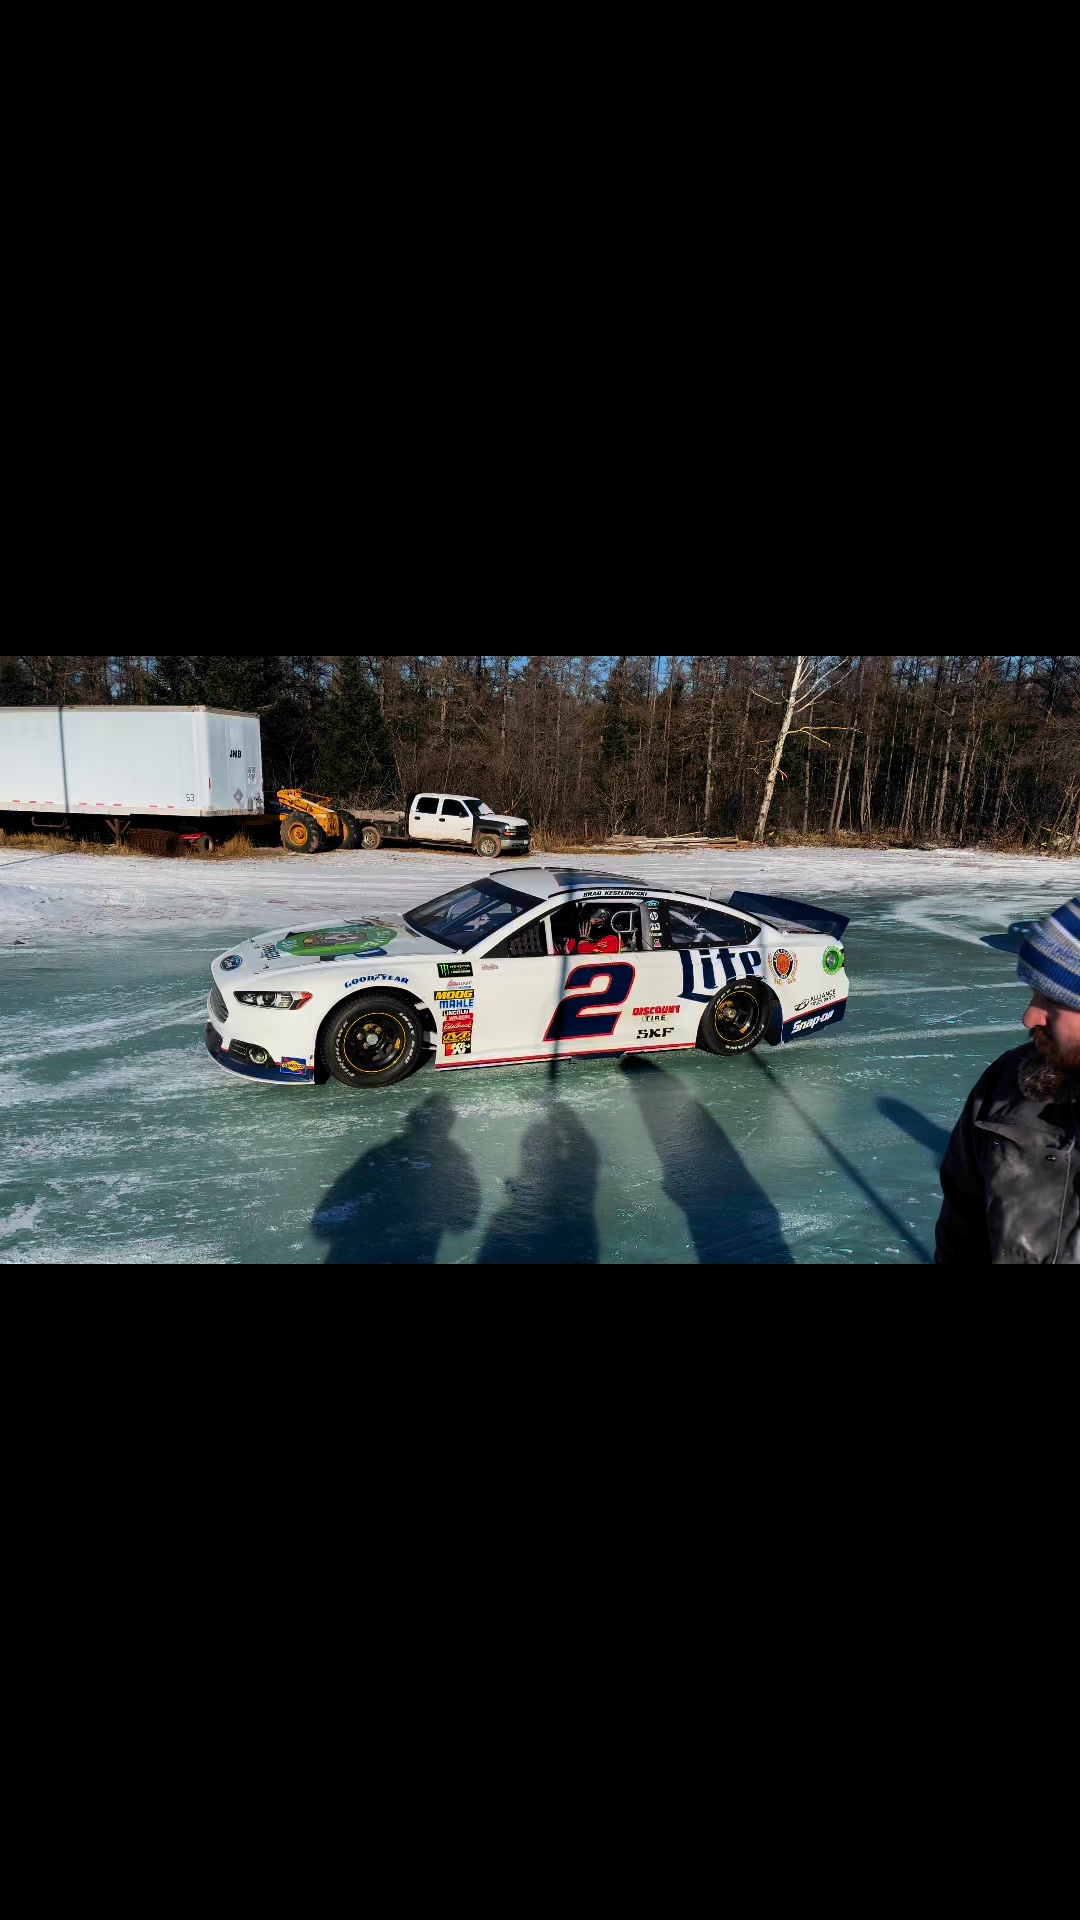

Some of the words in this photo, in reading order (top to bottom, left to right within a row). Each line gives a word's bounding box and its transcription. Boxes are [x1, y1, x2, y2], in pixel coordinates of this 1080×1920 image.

[186, 794, 195, 802] 53
[344, 973, 409, 988] GOODYEAR
[677, 949, 762, 1003] Lite
[436, 990, 473, 999] MOOG
[810, 989, 836, 1003] ALLIANCE
[439, 1000, 474, 1008] MAHLE
[543, 961, 635, 1042] 2
[632, 1005, 680, 1015] DISCOUNT
[636, 1027, 674, 1039] SKF
